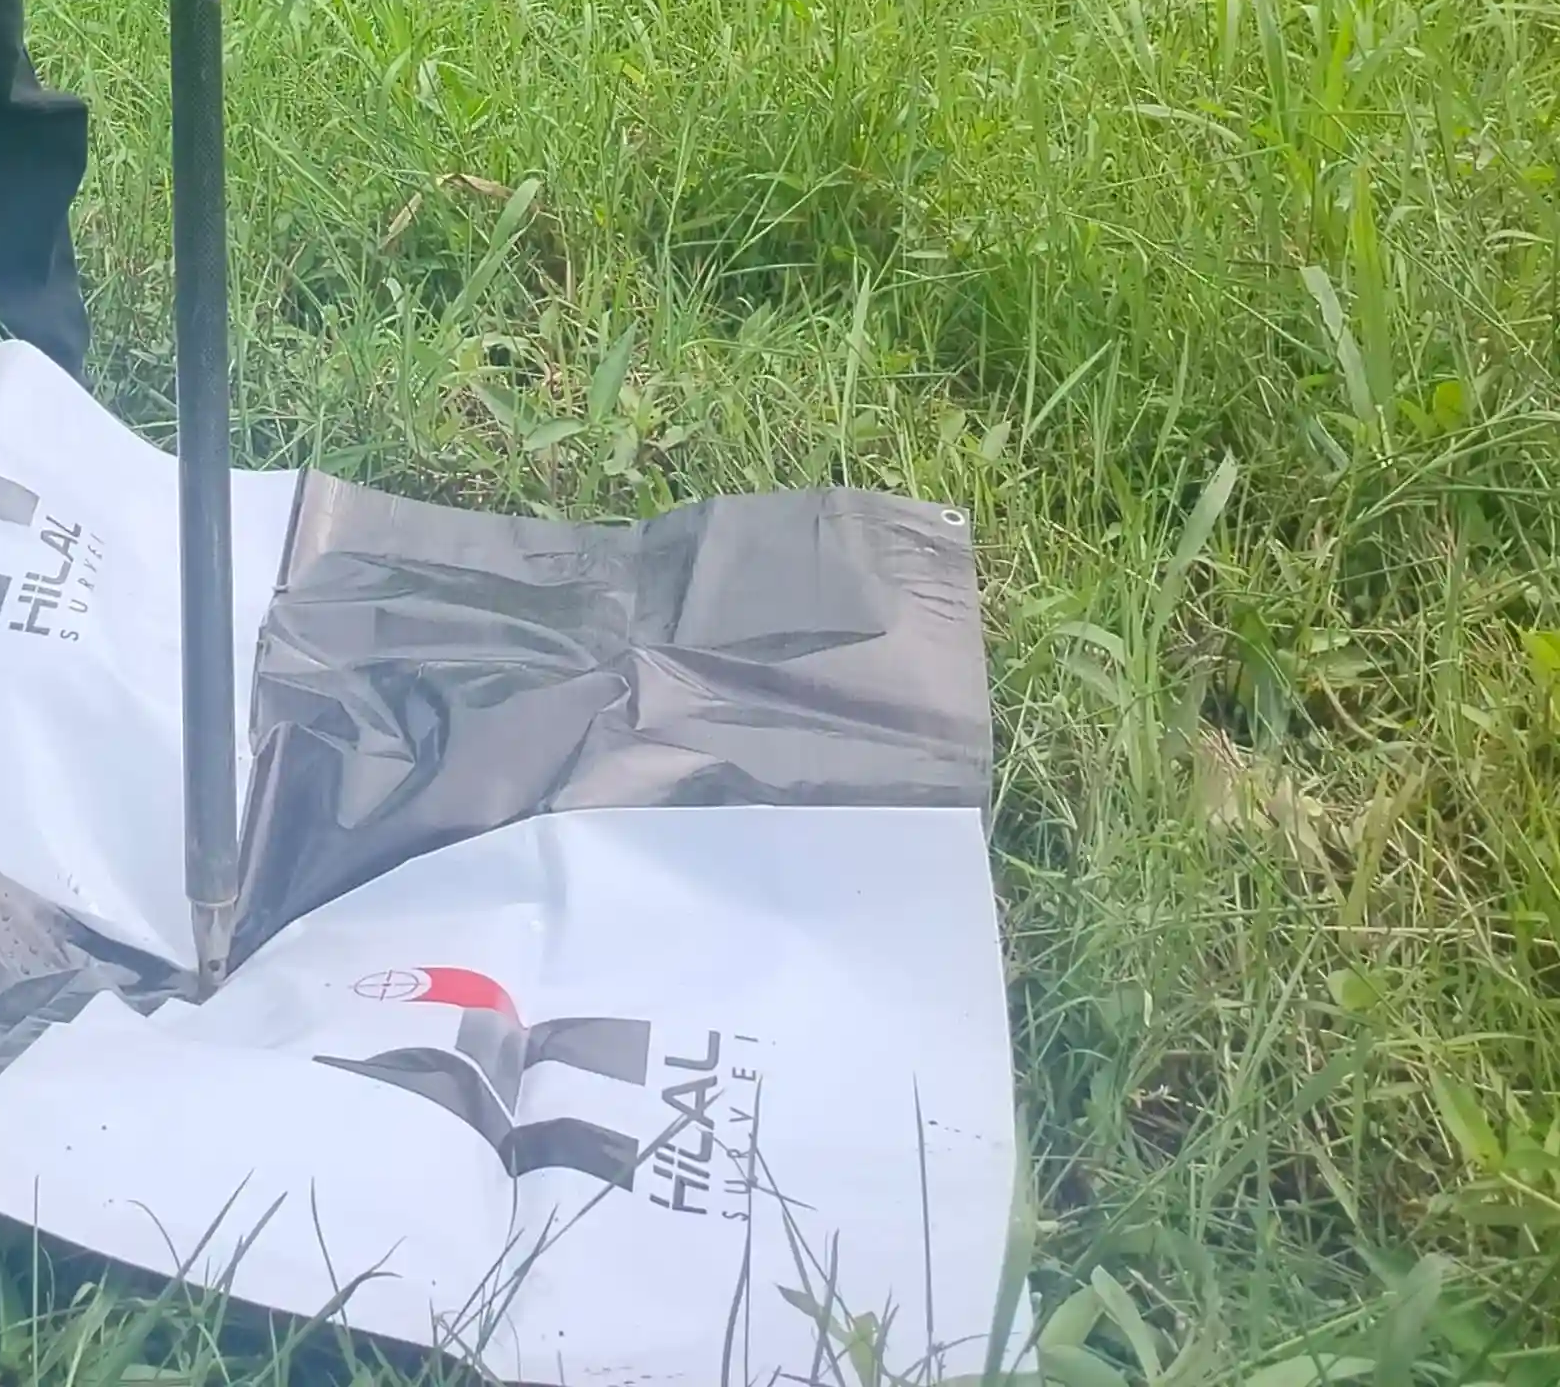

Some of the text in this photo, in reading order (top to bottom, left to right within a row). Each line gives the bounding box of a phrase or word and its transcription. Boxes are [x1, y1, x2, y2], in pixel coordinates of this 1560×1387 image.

[8, 515, 82, 636] HILAL
[59, 532, 106, 642] SURVEI
[649, 1030, 721, 1215] HILAL
[721, 1034, 759, 1222] SURVEI
